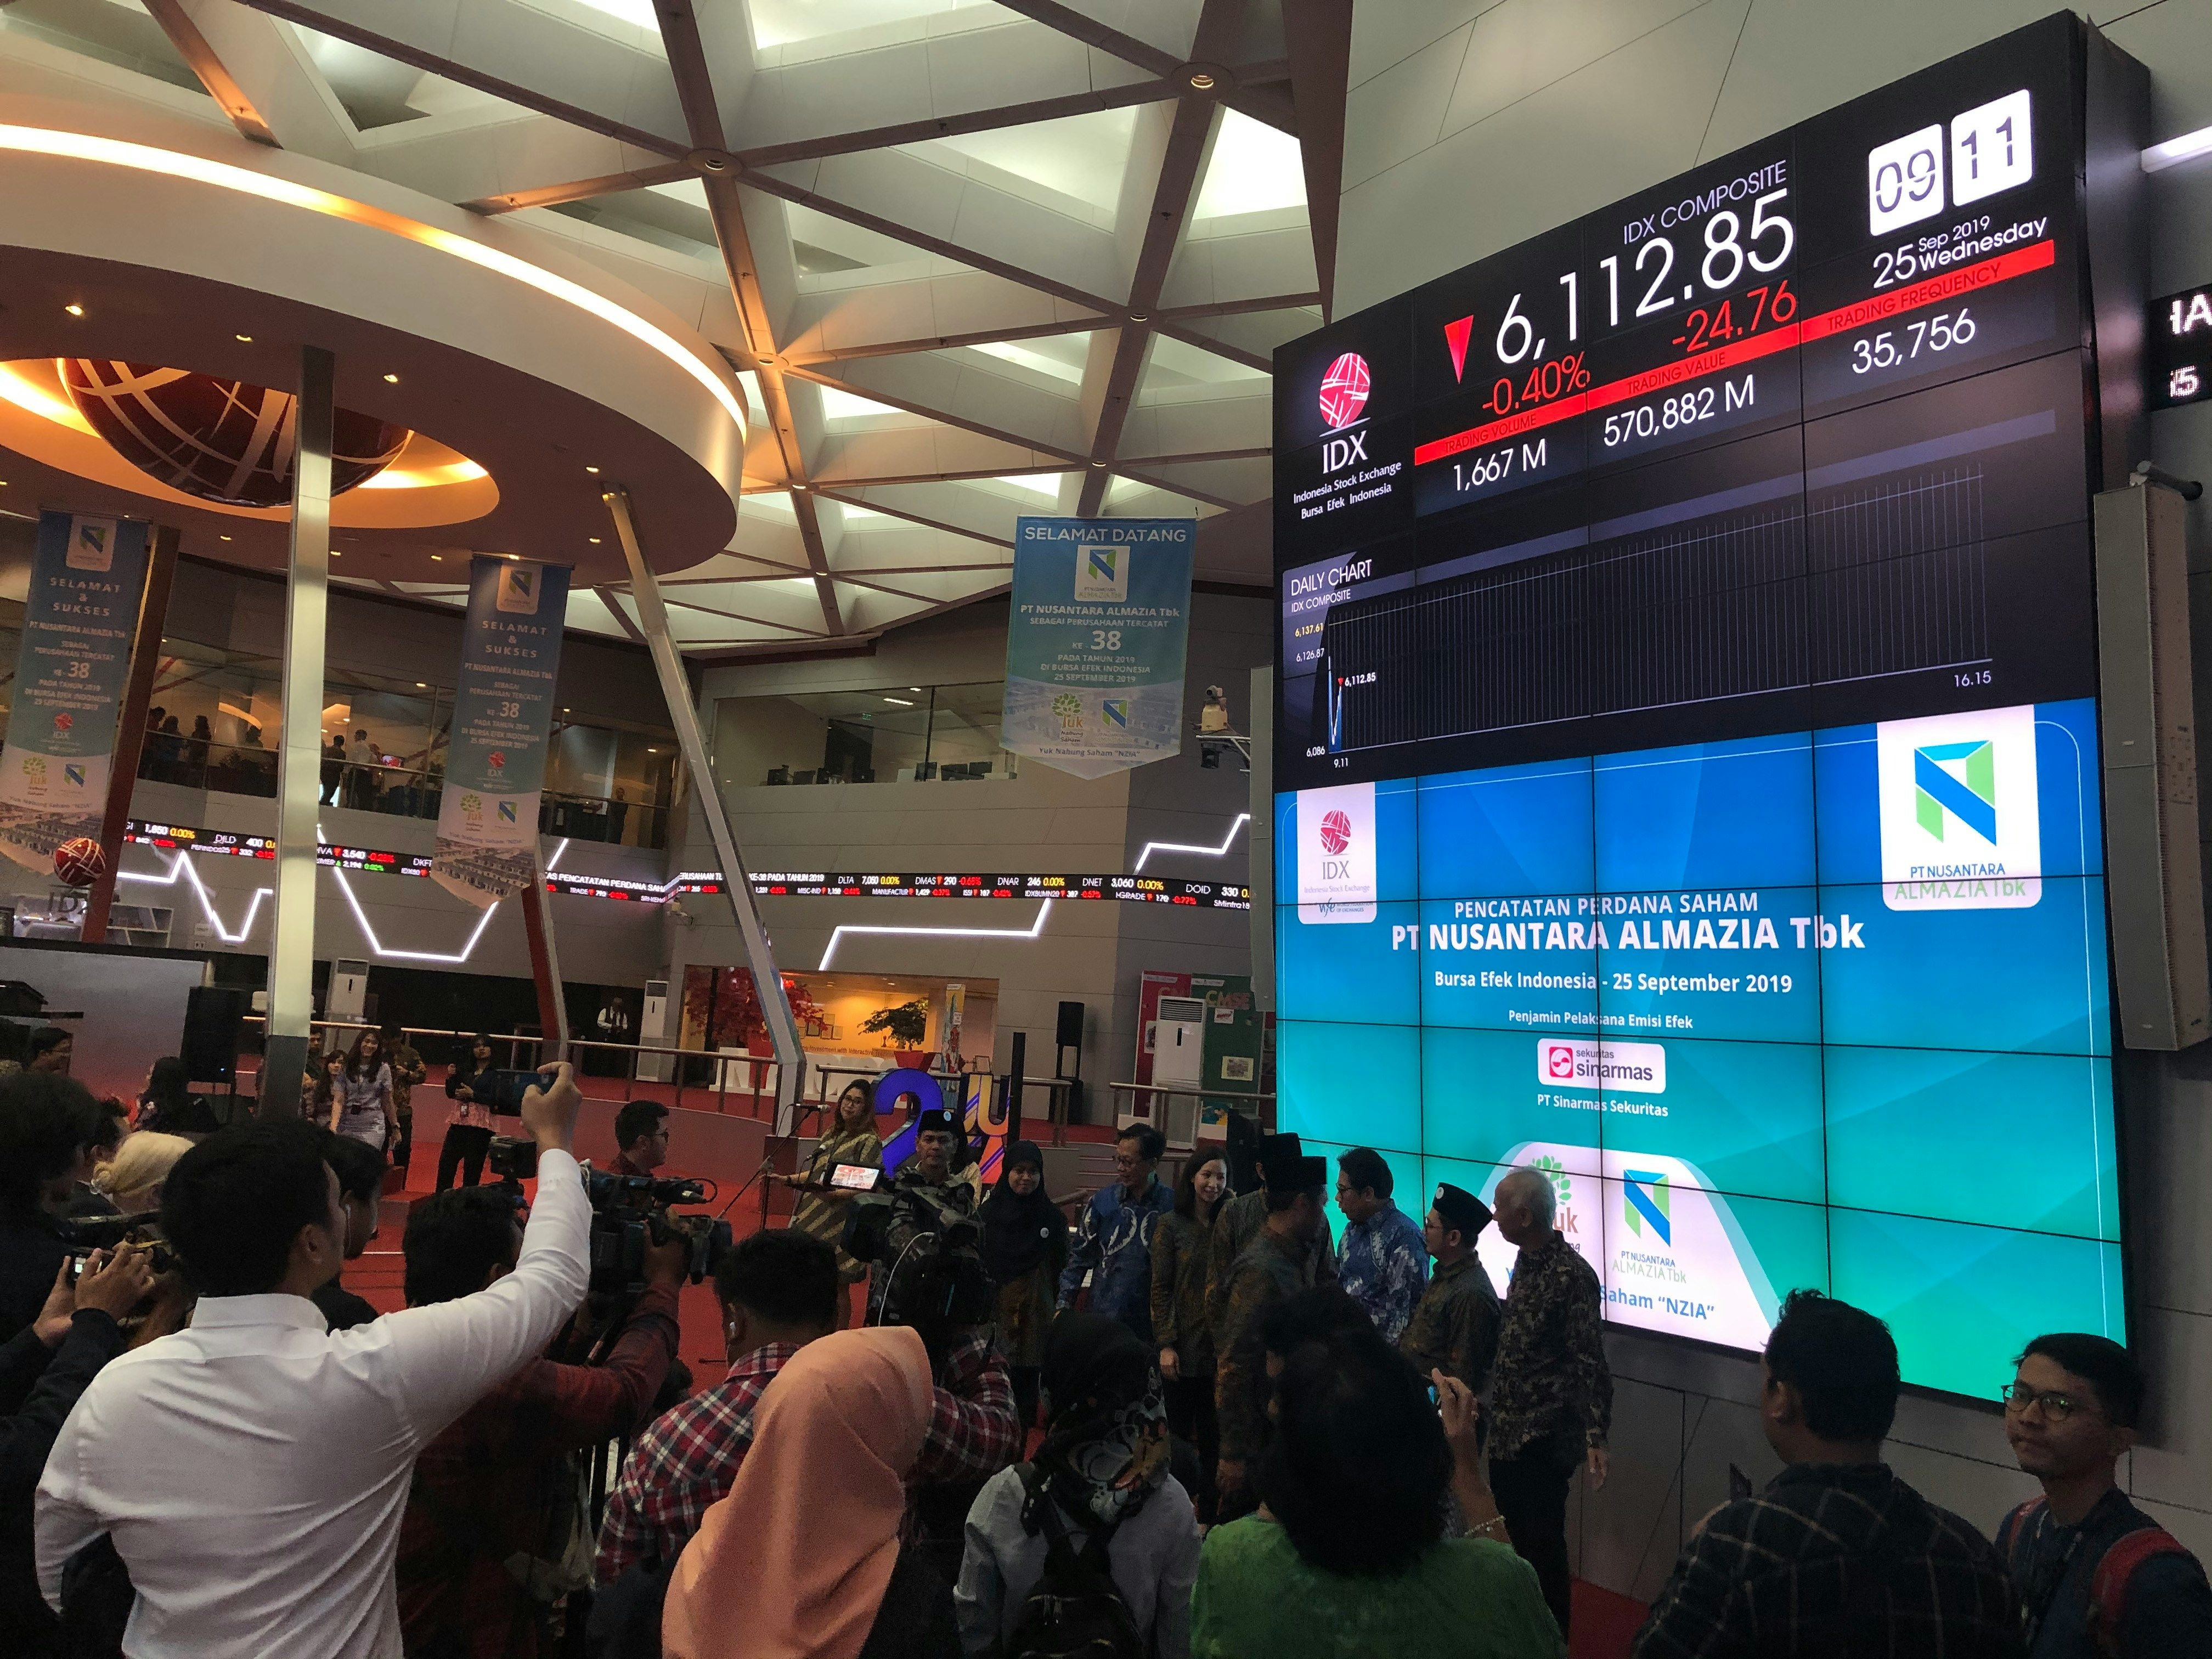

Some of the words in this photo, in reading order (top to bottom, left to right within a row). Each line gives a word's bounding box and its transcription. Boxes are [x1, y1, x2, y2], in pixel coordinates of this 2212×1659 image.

[1875, 148, 1936, 213] 09
[1961, 116, 2013, 179] 11
[1624, 214, 1655, 244] IDX
[1661, 160, 1786, 228] COMPOSITE
[1918, 233, 1949, 252] Sep
[1952, 215, 1990, 241] 2019
[1920, 217, 2047, 272] Wednesday
[1496, 188, 1794, 364] 6,112.85
[1873, 245, 1916, 289] 25
[1828, 298, 1895, 331] TRADING
[1901, 262, 2001, 306] FREQUENCY
[1672, 280, 1797, 353] -24.76
[1852, 308, 1976, 374] 35,756
[1627, 365, 1682, 394] TRADING
[1685, 352, 1725, 375] VALUE
[1482, 352, 1590, 414] -0.40%
[1604, 387, 1714, 446] 570,882
[1725, 374, 1754, 411] M
[1444, 430, 1489, 453] TRADING
[1491, 414, 1537, 438] VOLUME
[1322, 430, 1368, 474] IDX
[1454, 449, 1514, 491] 1,667
[1522, 438, 1546, 471] M
[1293, 483, 1332, 504] Indonesia
[1334, 476, 1357, 491] Stock
[1359, 461, 1402, 483] Exchange
[1301, 504, 1323, 519] Bursa
[1327, 496, 1345, 511] Efek
[1349, 483, 1391, 504] Indonesia
[1024, 527, 1108, 542] SELAMAT
[1112, 529, 1186, 542] DATANG
[49, 577, 121, 593] SELAMAT
[1291, 572, 1325, 596] DAILY
[1328, 559, 1372, 586] CHART
[53, 602, 110, 616] SUKSES
[1291, 600, 1304, 613] IDX
[1306, 589, 1351, 609] COMPOSITE
[1020, 605, 1034, 613] PT
[1036, 605, 1104, 616] NUSANTARA
[1107, 607, 1156, 616] ALMAZIA
[1160, 608, 1180, 617] Tbk
[482, 620, 547, 635] SELAMAT
[1295, 622, 1324, 637] 6,137.61
[508, 635, 517, 644] &
[1091, 630, 1121, 650] 38
[485, 645, 538, 658] SUKSES
[1296, 648, 1324, 663] 6,126.87
[68, 661, 90, 679] 38
[1066, 674, 1114, 682] SEPTEMBER
[1345, 672, 1376, 687] 6,112.85
[1954, 670, 1992, 687] 16.15
[499, 701, 520, 718] 38
[1306, 747, 1325, 758] 6,086
[1334, 758, 1348, 769] 9.11
[768, 873, 785, 882] PADA
[787, 873, 809, 882] TAHUN
[1322, 860, 1350, 879] IDX
[1910, 866, 1924, 878] PT
[1927, 863, 2005, 878] NUSANTARA
[558, 873, 609, 887] PENCATATAN
[611, 879, 646, 890] PERDANA
[881, 876, 900, 885] 0.00%
[915, 877, 936, 885] DMAS
[944, 876, 956, 885] 290
[997, 877, 1019, 885] DNAR
[1027, 877, 1041, 886] 246
[1043, 877, 1065, 886] 0.00%
[1082, 878, 1103, 887] DNET
[1137, 879, 1164, 890] 0.00%
[1186, 884, 1211, 894] DOID
[1221, 887, 1239, 897] 330
[1455, 899, 1570, 918] PENCATATAN
[1578, 895, 1673, 916] PERDANA
[1680, 892, 1758, 913] SAHAM
[1392, 925, 1420, 950] PT
[1430, 921, 1610, 950] NUSANTARA
[1618, 917, 1779, 950] ALMAZIA
[1790, 914, 1865, 949] Tbk
[1435, 971, 1476, 986] Bursa
[1481, 972, 1513, 988] Efek
[1517, 972, 1596, 990] Indonesia
[1613, 973, 1632, 990] 25
[1638, 973, 1740, 995] September
[1746, 974, 1792, 992] 2019
[1508, 1010, 1561, 1025] Penjamin
[1565, 1012, 1624, 1026] Pelaksana
[1629, 1014, 1661, 1028] Emisi
[1665, 1014, 1693, 1029] Efek
[1576, 1048, 1614, 1059] sekuritas
[1577, 1059, 1653, 1081] sinarmas
[1538, 1094, 1551, 1106] PT
[1553, 1096, 1607, 1111] Sinarmas
[1610, 1100, 1668, 1117] Sekuritas
[1553, 1207, 1578, 1233] uk
[1621, 1251, 1629, 1259] PT
[1631, 1252, 1675, 1267] NUSANTARA
[1612, 1259, 1665, 1280] ALMAZIA
[1667, 1268, 1686, 1283] Tbk
